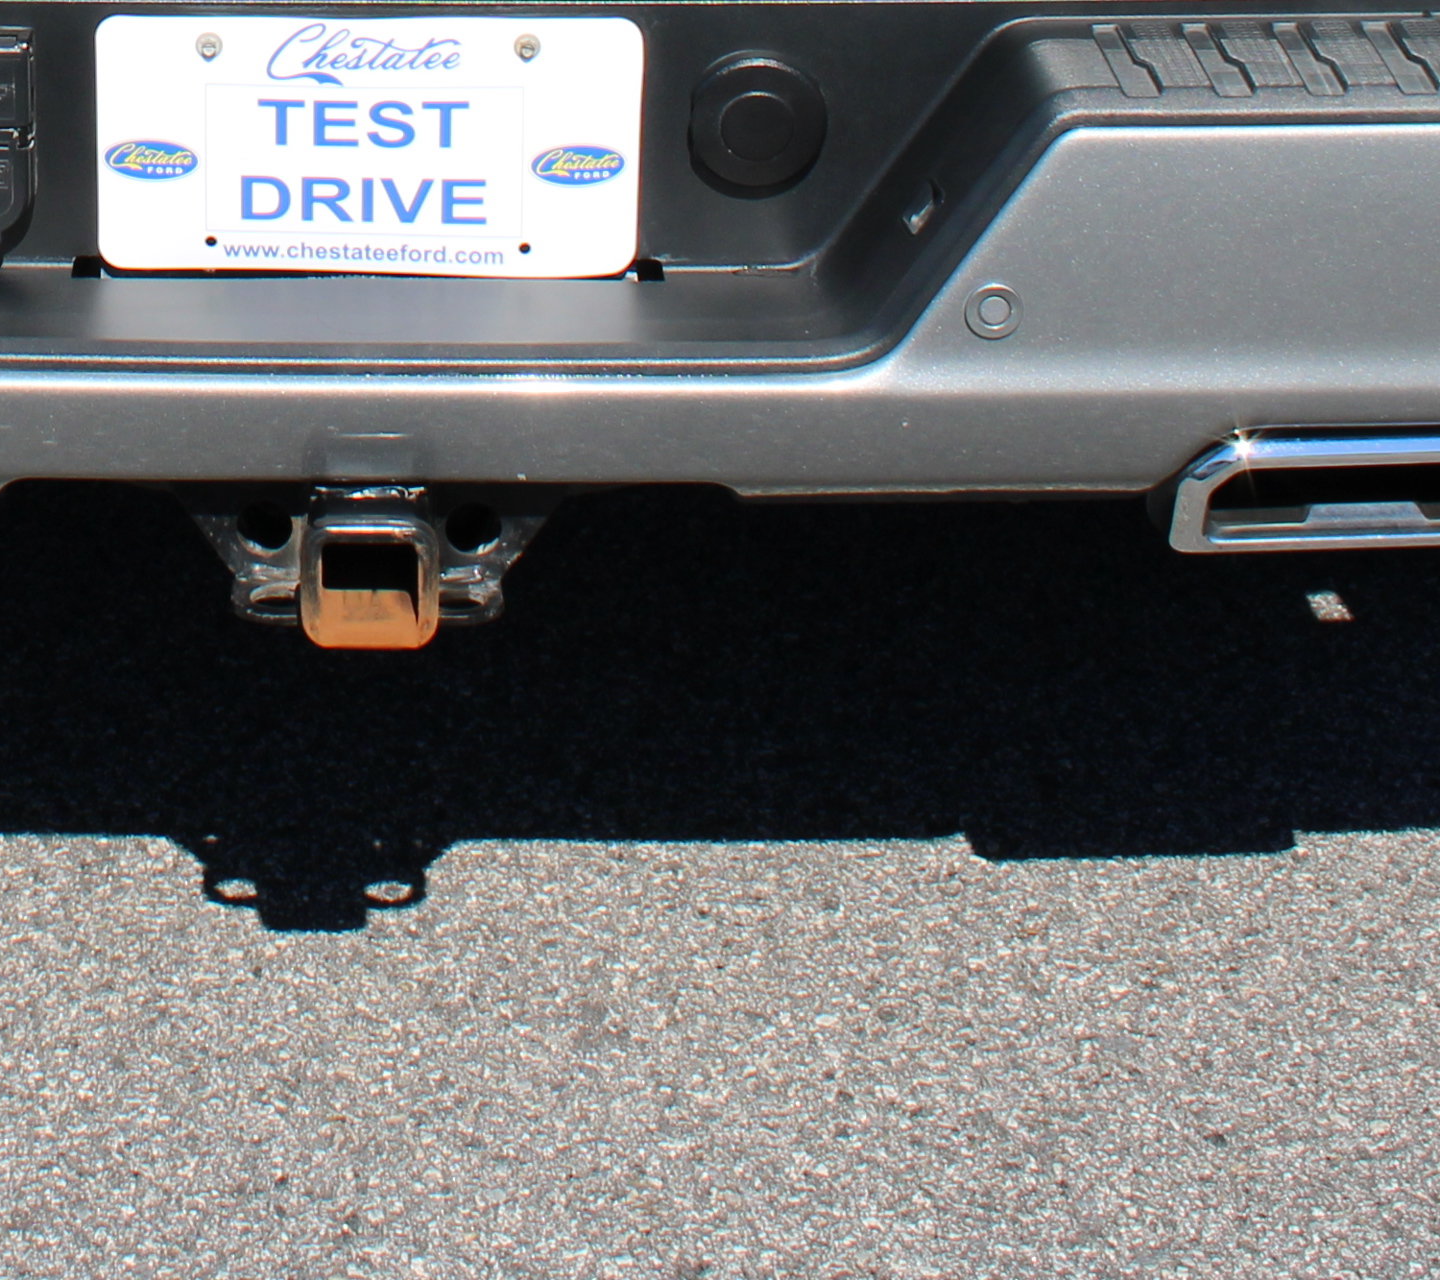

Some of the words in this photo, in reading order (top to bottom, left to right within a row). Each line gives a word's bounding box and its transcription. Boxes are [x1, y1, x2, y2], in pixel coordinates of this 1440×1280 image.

[266, 22, 462, 87] Chestatee
[257, 98, 470, 149] TEST
[108, 142, 193, 170] Chestatee
[536, 149, 620, 176] Chestatee
[146, 166, 184, 175] FORD
[573, 170, 611, 180] FORD
[240, 174, 488, 225] DRIVE
[222, 241, 505, 265] www.chestateeford.com
